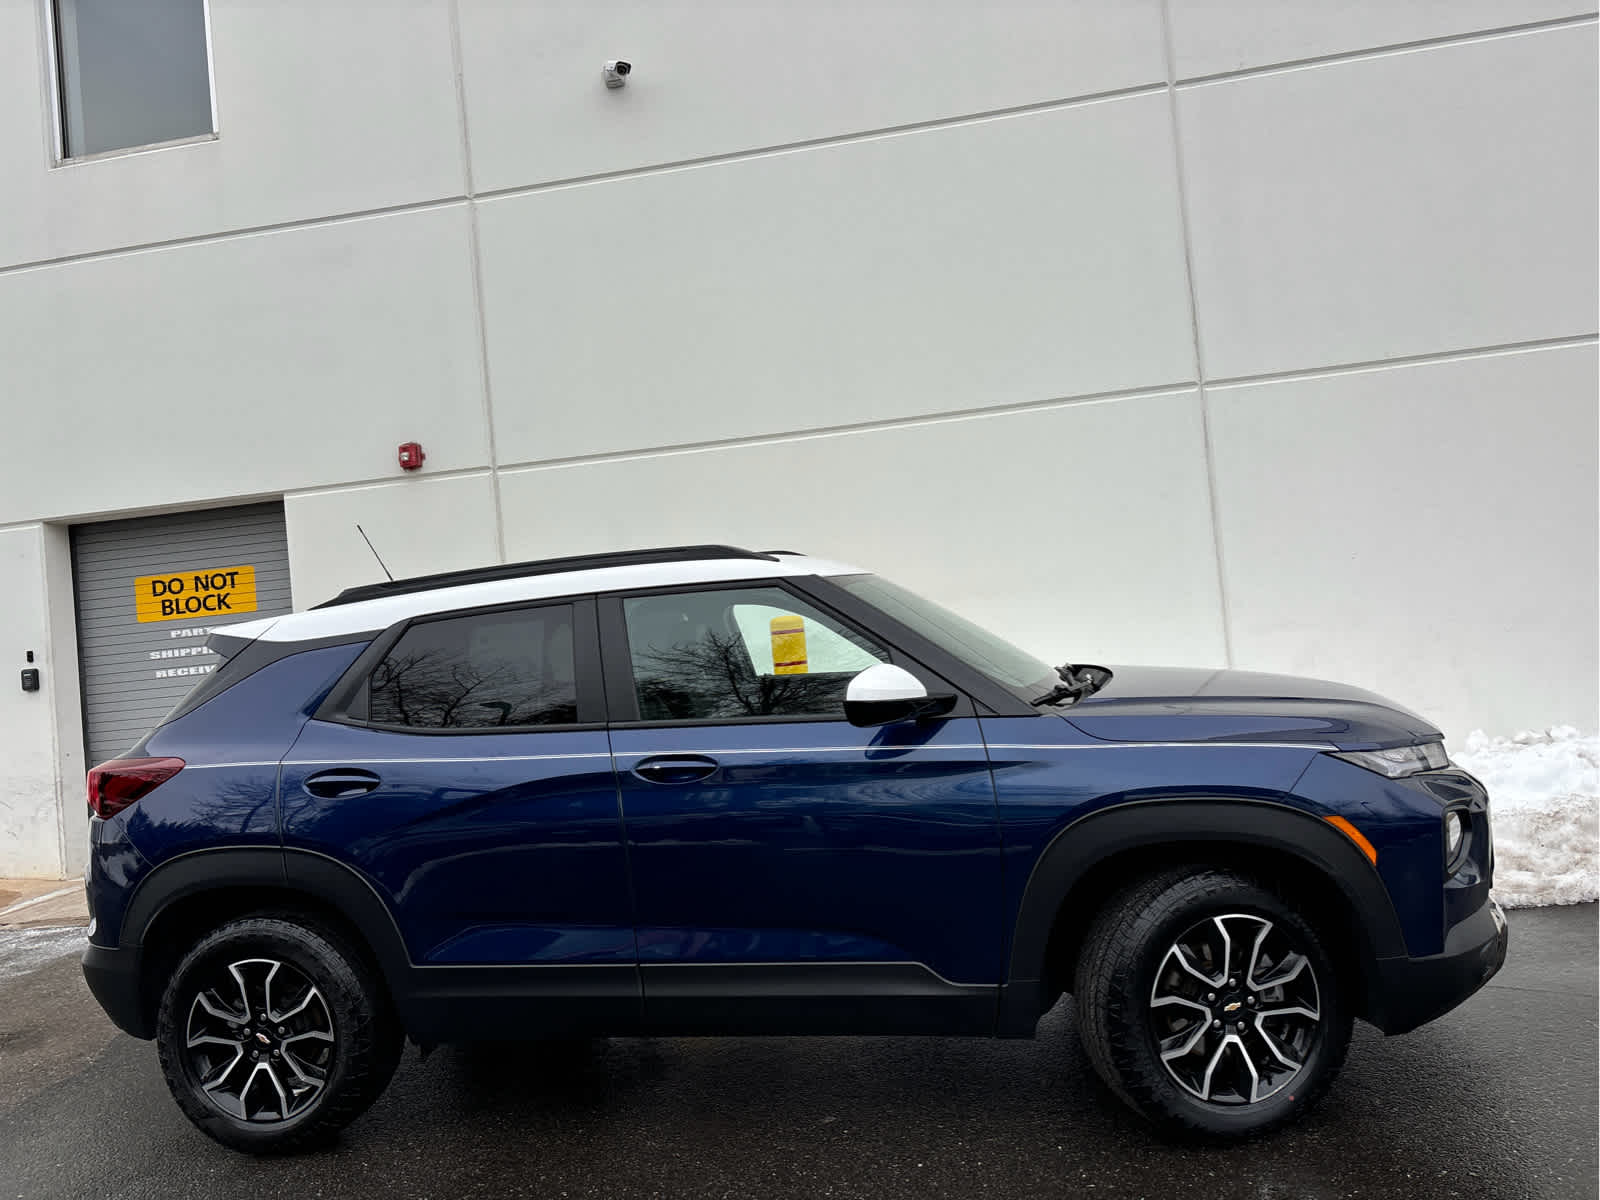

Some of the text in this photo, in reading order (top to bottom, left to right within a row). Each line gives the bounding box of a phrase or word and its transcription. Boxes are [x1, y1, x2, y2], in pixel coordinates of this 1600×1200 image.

[152, 572, 239, 597] DO NOT
[162, 593, 232, 616] BLOCK
